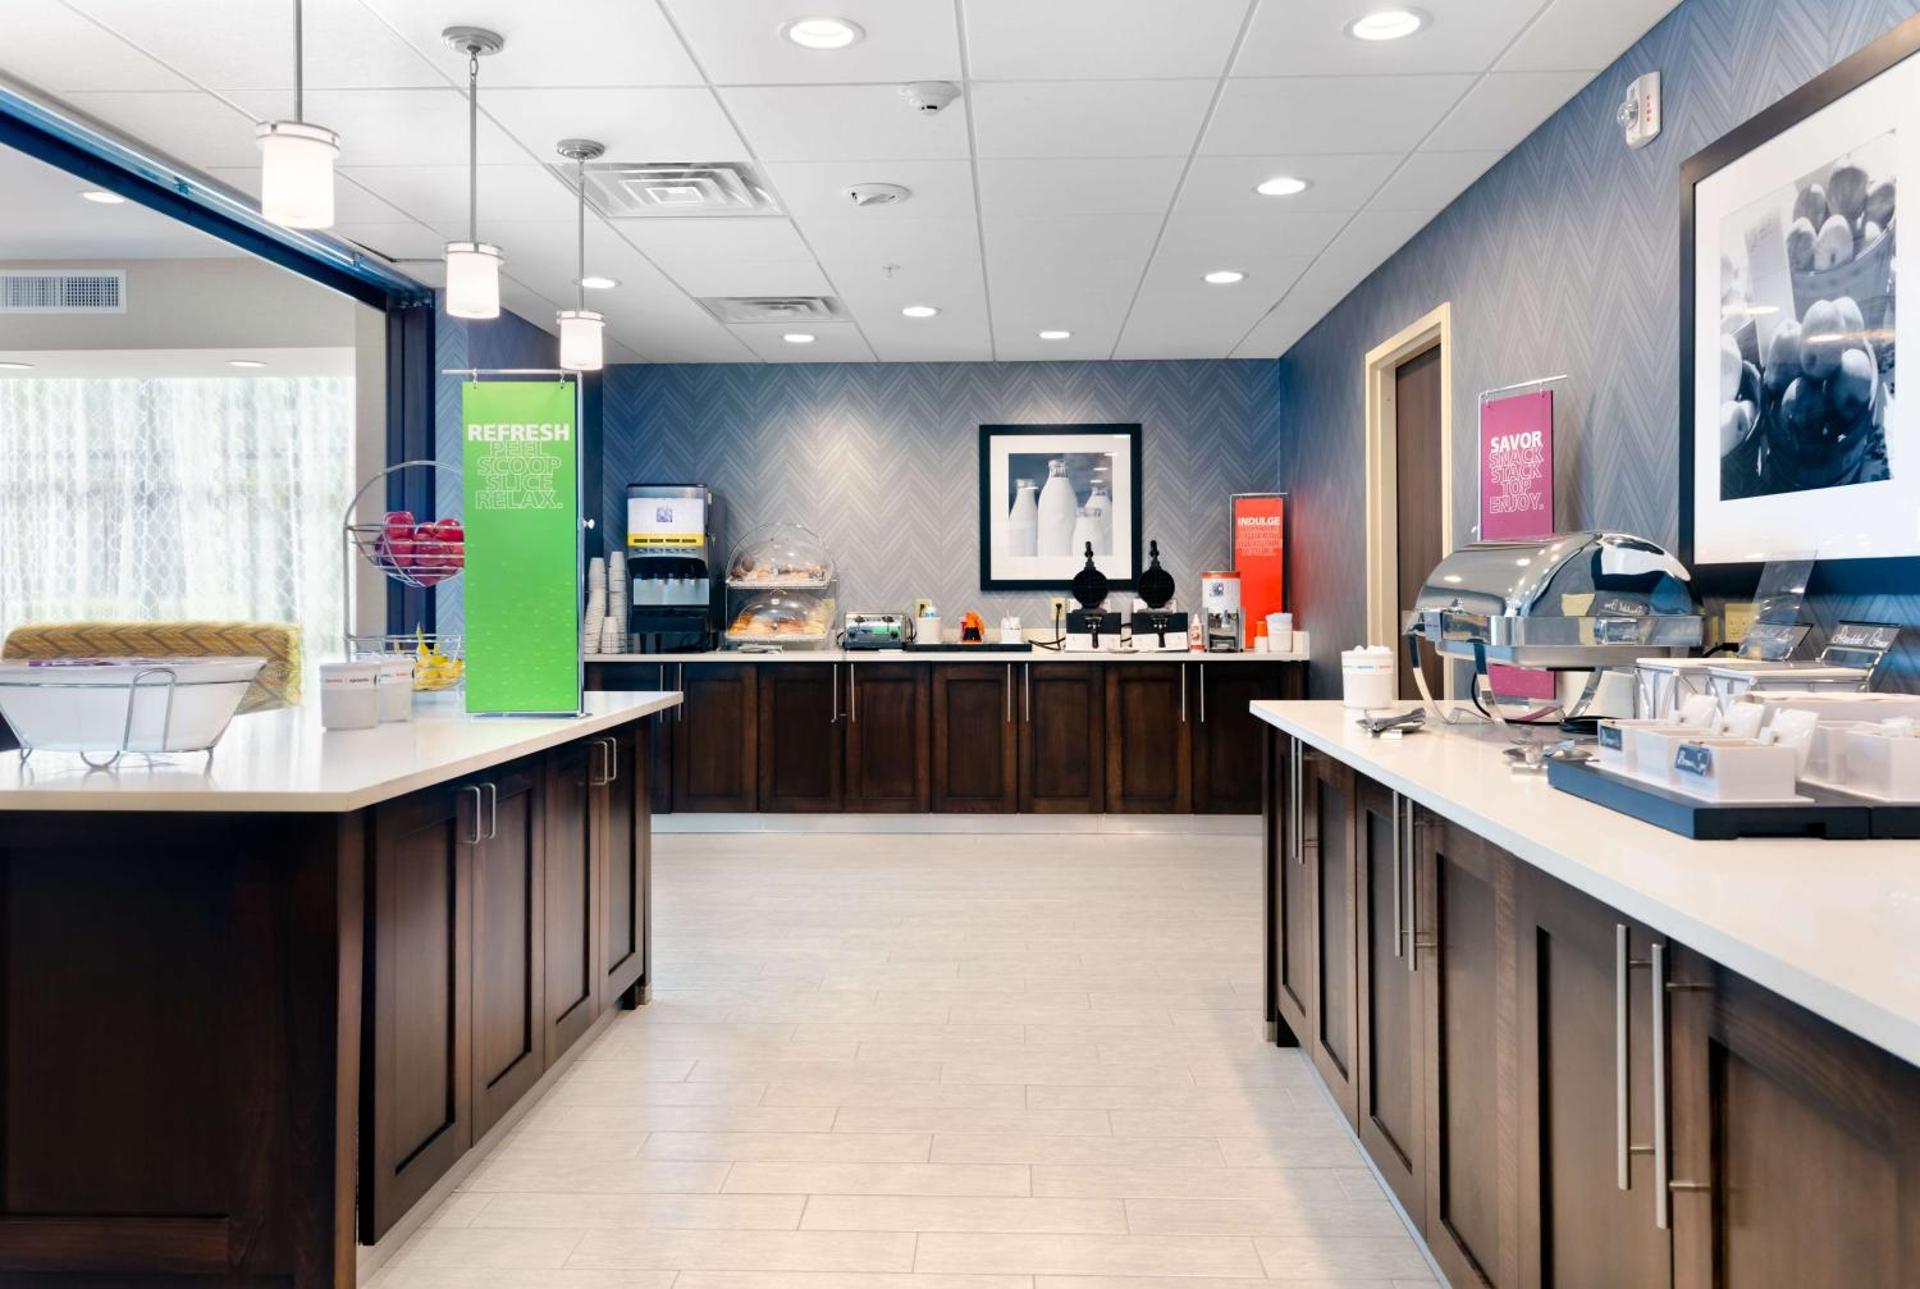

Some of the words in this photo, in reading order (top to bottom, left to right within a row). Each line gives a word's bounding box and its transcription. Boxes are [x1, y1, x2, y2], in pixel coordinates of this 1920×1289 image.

[468, 424, 570, 441] REFRESH
[1490, 431, 1542, 453] SAVOR
[477, 456, 561, 476] SCOOP
[1489, 444, 1544, 469] SNACK
[486, 474, 553, 491] SLICE
[1491, 464, 1542, 484] STACK
[1499, 479, 1532, 497] TOP
[475, 490, 564, 509] RELAX.
[1490, 492, 1545, 514] ENJOY.
[1237, 516, 1281, 526] INDULGE
